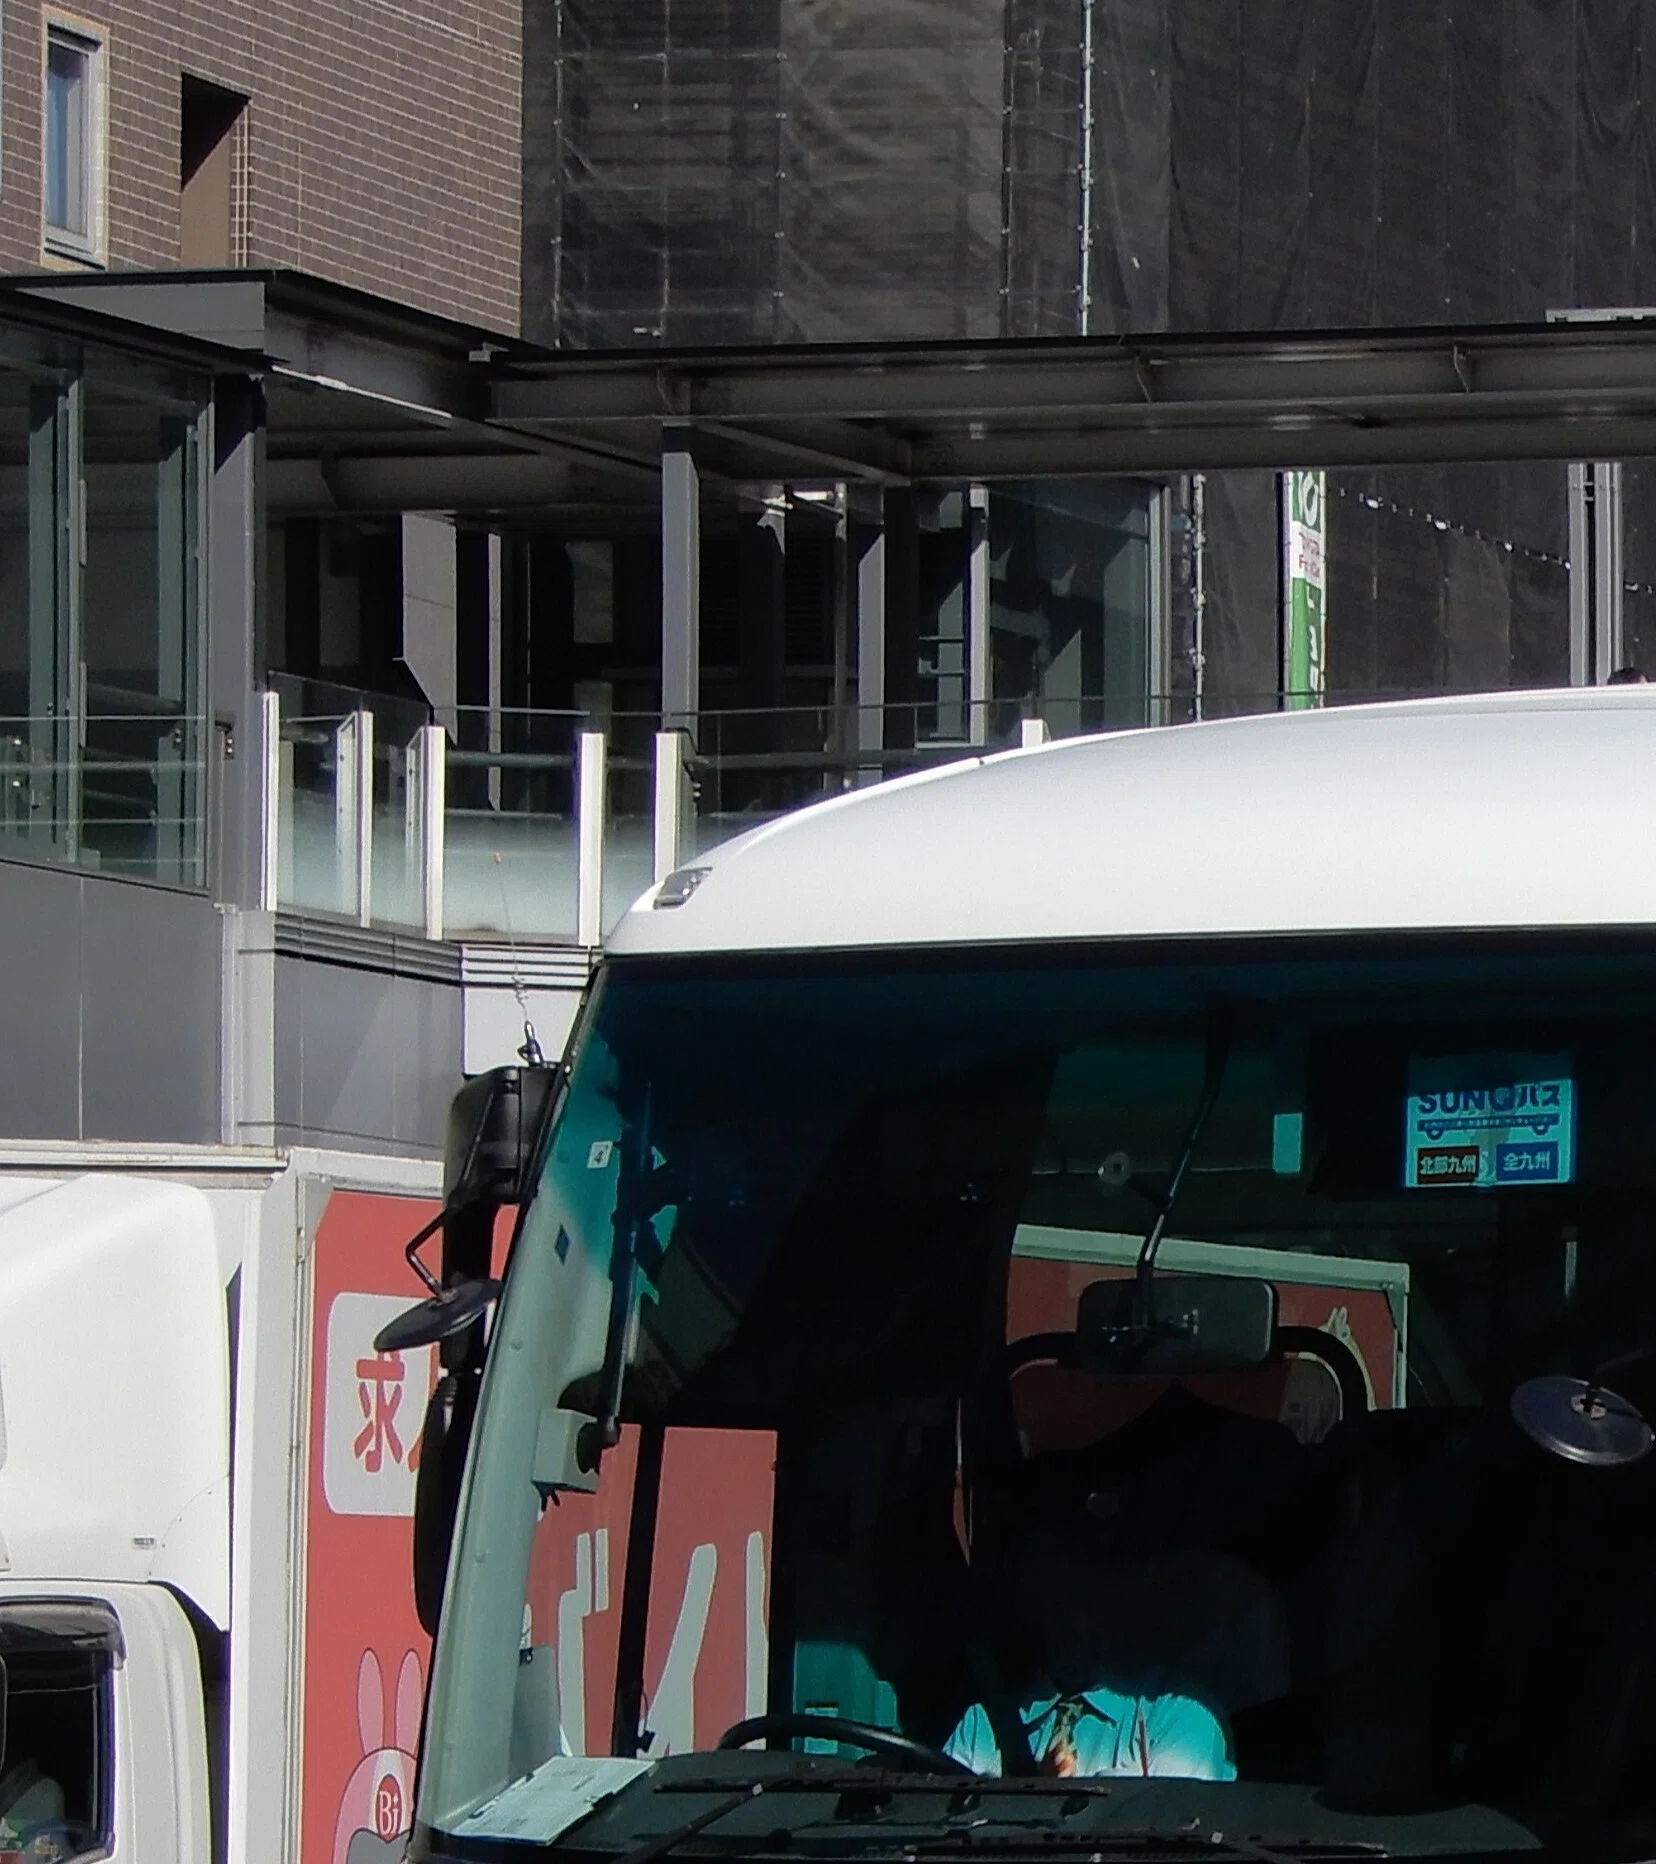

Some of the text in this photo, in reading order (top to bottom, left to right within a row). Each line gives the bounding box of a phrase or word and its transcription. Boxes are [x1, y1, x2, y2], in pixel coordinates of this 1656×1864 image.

[1419, 1154, 1477, 1175] 北部九州
[1503, 1151, 1550, 1172] 全九州
[354, 1343, 441, 1473] 求
